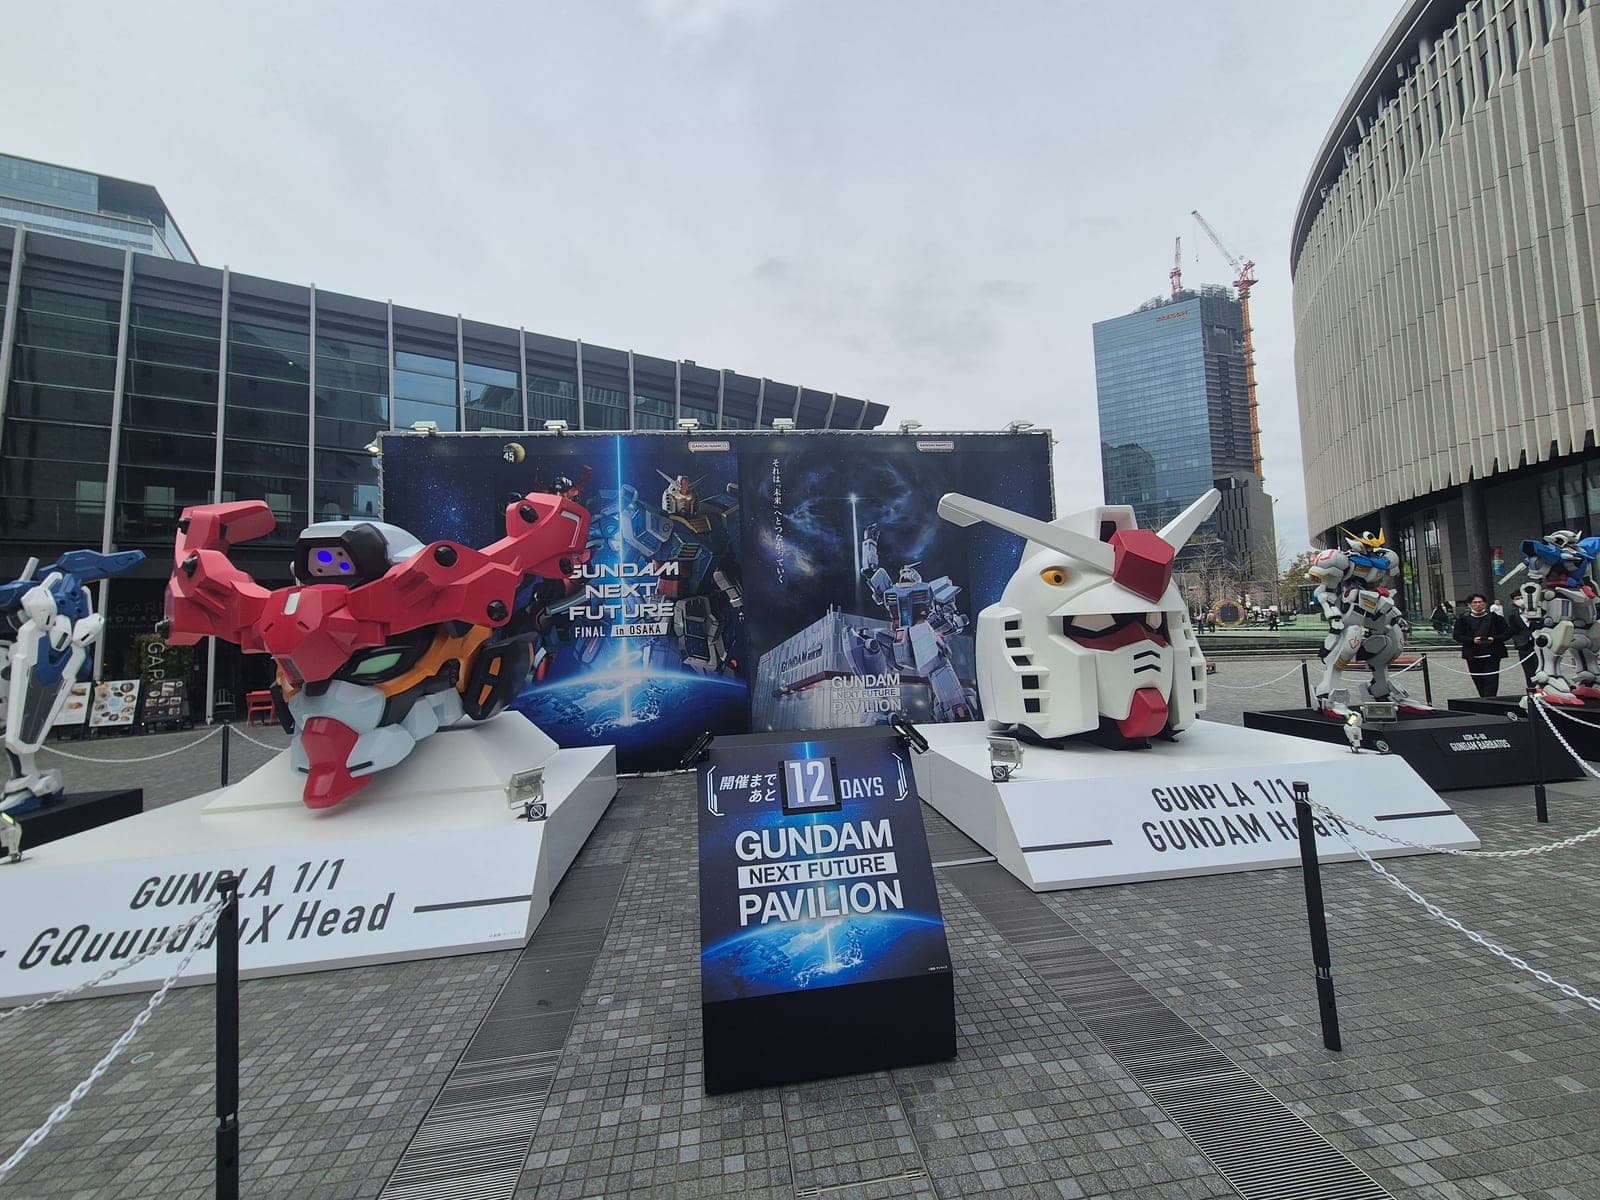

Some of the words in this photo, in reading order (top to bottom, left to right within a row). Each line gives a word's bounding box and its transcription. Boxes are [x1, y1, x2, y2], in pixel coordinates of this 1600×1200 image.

[585, 583, 657, 599] NEXT
[569, 603, 674, 621] FUTURE
[575, 626, 605, 638] FINAL
[616, 627, 624, 635] in
[629, 625, 661, 635] OSAKA
[831, 673, 900, 689] GUNDAM
[837, 690, 859, 699] NEXT
[862, 688, 896, 697] FUTURE
[834, 698, 902, 715] PAVILION
[719, 773, 777, 791] 開催まで
[789, 761, 829, 803] 12
[840, 776, 884, 799] DAYS
[749, 788, 776, 803] あと
[1151, 782, 1255, 813] GUNPLA
[1253, 778, 1295, 804] 1/1
[735, 819, 893, 861] GUNDAM
[1141, 812, 1272, 853] GUNDAM
[292, 858, 345, 893] 1/1
[749, 864, 802, 885] NEXT
[807, 856, 886, 879] FUTURE
[738, 879, 904, 927] PAVILION
[287, 892, 395, 940] Head
